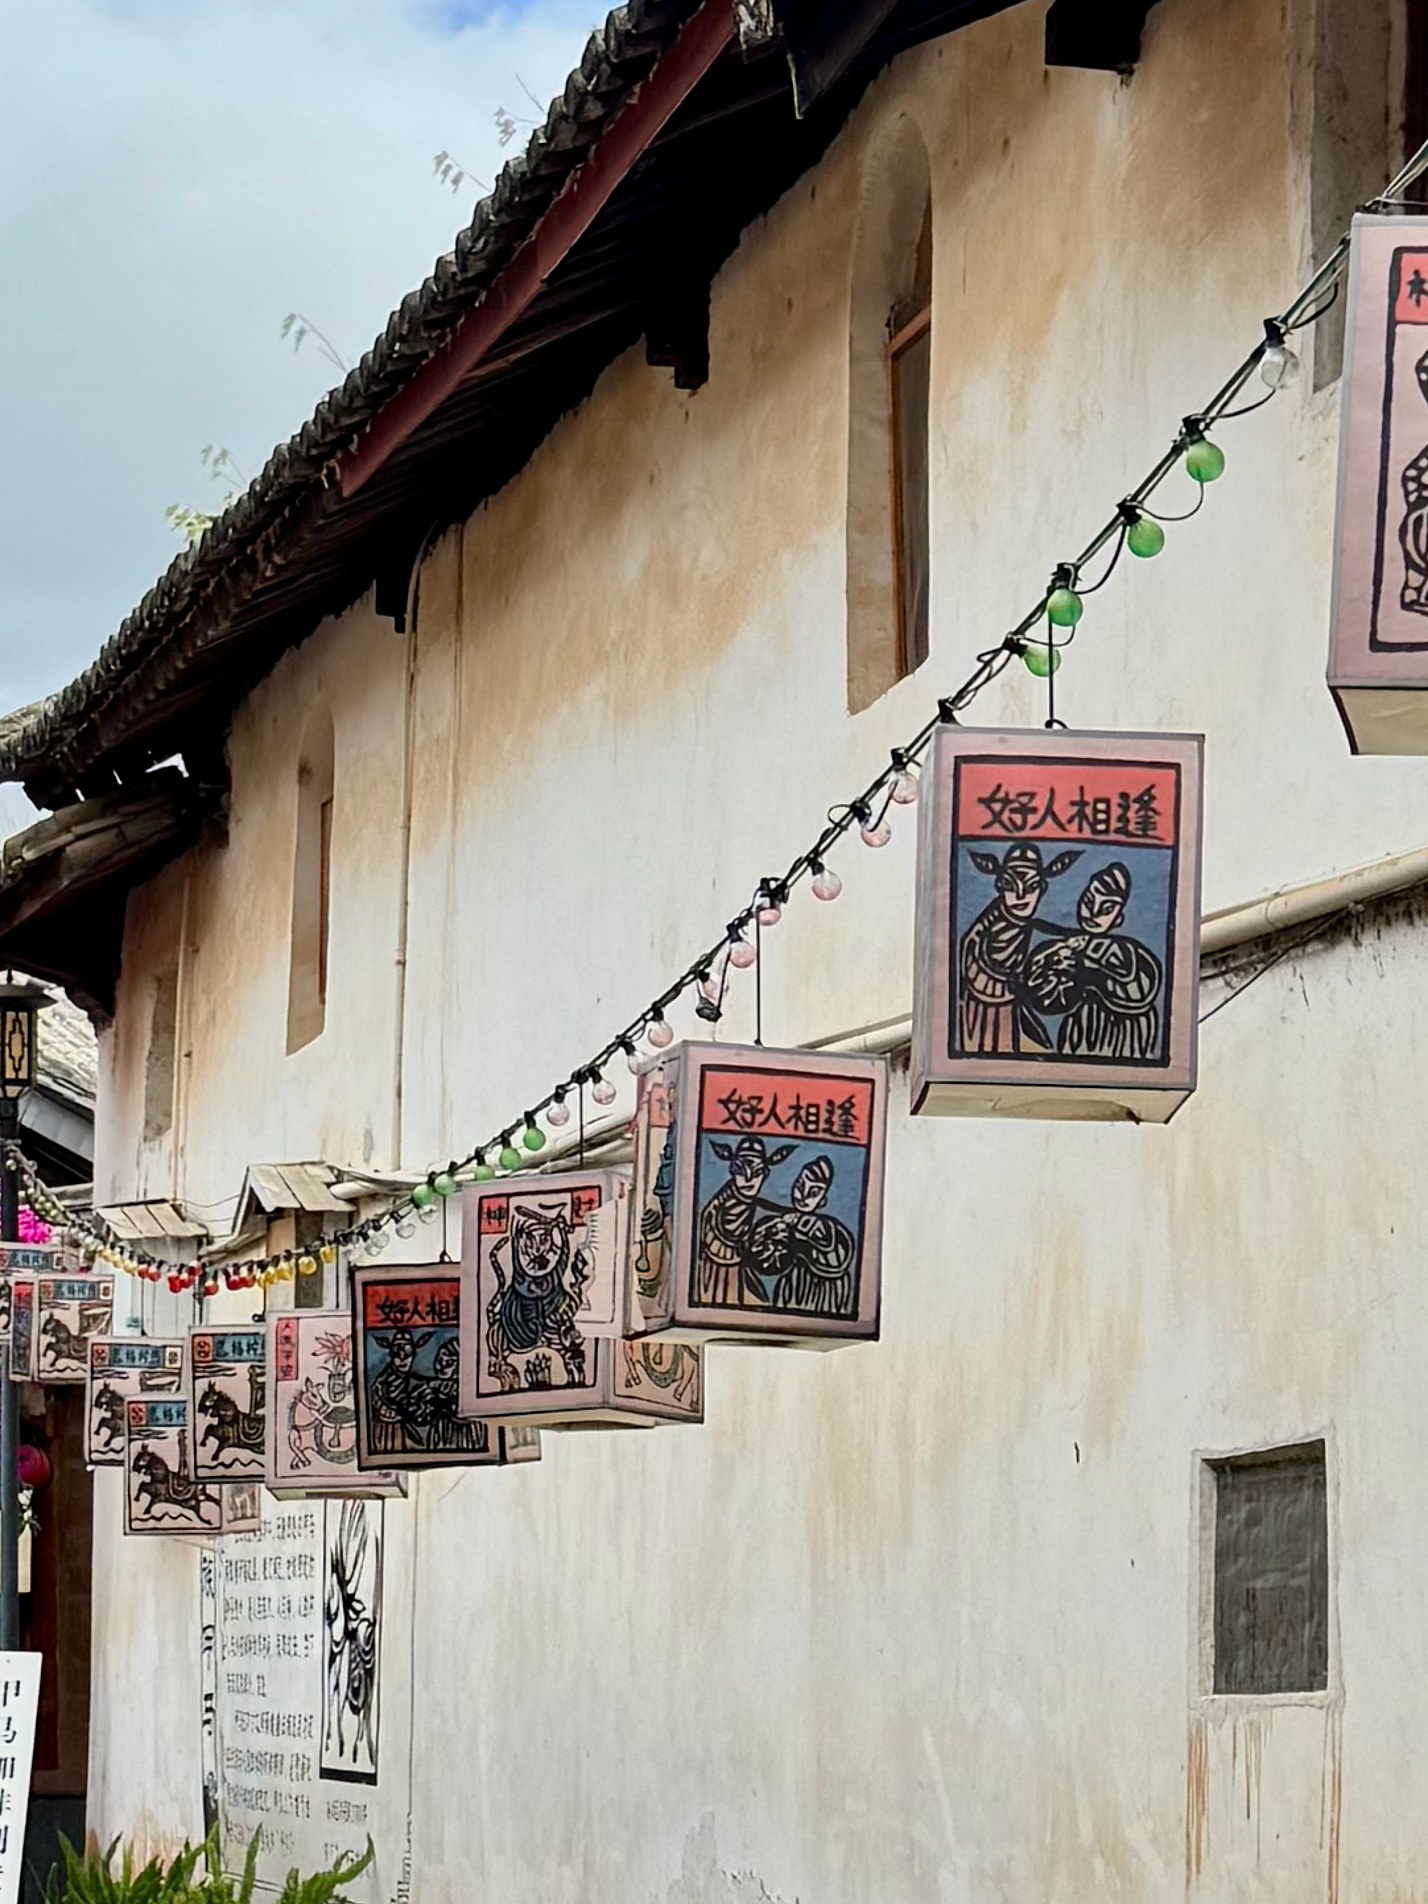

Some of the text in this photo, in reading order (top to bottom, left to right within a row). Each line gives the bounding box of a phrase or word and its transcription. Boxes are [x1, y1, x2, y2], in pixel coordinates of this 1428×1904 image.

[977, 783, 1166, 841] 好人相逢
[717, 1087, 862, 1141] 好人相逢
